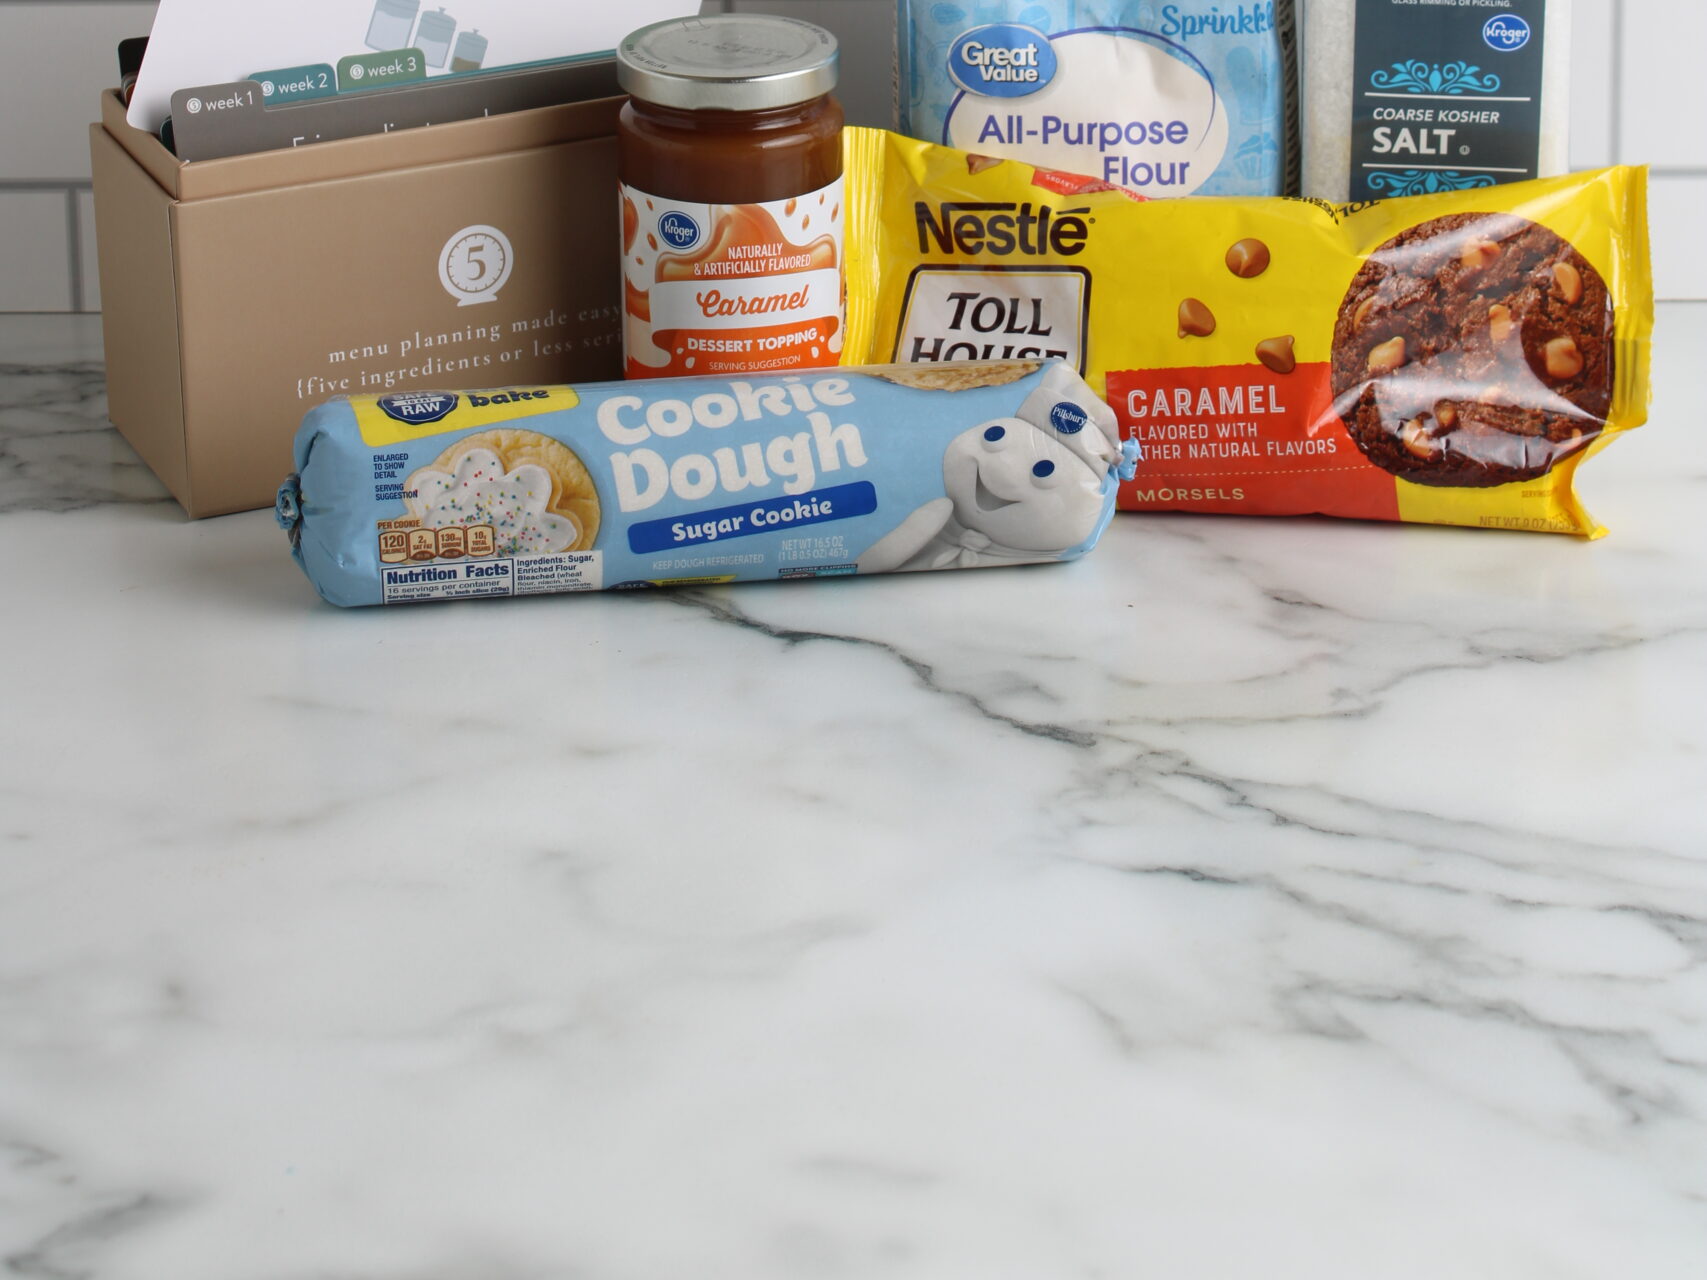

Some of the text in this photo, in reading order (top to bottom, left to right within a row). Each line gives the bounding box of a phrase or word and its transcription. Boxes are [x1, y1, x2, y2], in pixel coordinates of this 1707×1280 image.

[1486, 21, 1527, 44] Kroger
[961, 41, 1039, 67] Great
[368, 60, 403, 78] week
[407, 57, 417, 72] 3
[980, 65, 1039, 83] Value
[278, 75, 315, 94] week
[318, 73, 328, 89] 2
[205, 93, 244, 112] week
[247, 91, 254, 105] 1
[1373, 108, 1500, 124] COARSE KOSHER
[977, 115, 1189, 152] All-Purpose
[1372, 126, 1456, 155] SALT
[1103, 157, 1190, 186] Flour
[664, 217, 694, 243] Kroger
[915, 201, 1091, 256] Nestlé
[728, 243, 783, 259] NATURALLY
[467, 244, 486, 280] 5
[694, 254, 811, 275] & ARTIFICIALLY FLAVORED
[696, 284, 810, 318] Caramel
[946, 292, 1053, 336] TOLL
[328, 305, 620, 363] menu planning made easy
[687, 327, 818, 353] DESSERT TOPPING
[910, 337, 1068, 363] HOU
[361, 352, 491, 388] ingredients
[500, 349, 523, 363] or
[534, 339, 573, 356] less
[709, 355, 801, 371] SERVING SUGGESTION
[401, 401, 440, 416] RAW
[467, 389, 551, 407] bake
[1127, 384, 1286, 418] CARAMEL
[597, 377, 857, 445] Cookie
[1053, 406, 1087, 426] Pillsbury
[1129, 422, 1258, 441] FLAVORED WITH
[373, 453, 409, 463] ENLARGED
[1140, 438, 1337, 460] THER NATURAL FLAVORS
[373, 462, 405, 471] TO SHOW
[609, 411, 869, 513] Dough
[374, 471, 398, 479] DETAIL
[375, 483, 404, 492] SERVING
[375, 489, 418, 501] SUGGESTION
[1137, 488, 1244, 502] MORSELS
[377, 519, 421, 529] PER COOKIE
[672, 497, 833, 542] Sugar Cookie
[1479, 515, 1502, 528] NET
[383, 534, 405, 548] 120
[782, 535, 844, 551] NET WT 16.5 OZ
[516, 554, 594, 567] Ingredients: Sugar,
[517, 565, 554, 574] Enriched
[653, 553, 764, 570] KEEP DOUGH REFRIGERATED
[387, 563, 509, 584] Nutrition Facts
[517, 571, 582, 581] Bleached (wheat
[388, 580, 501, 594] 16 servings per container
